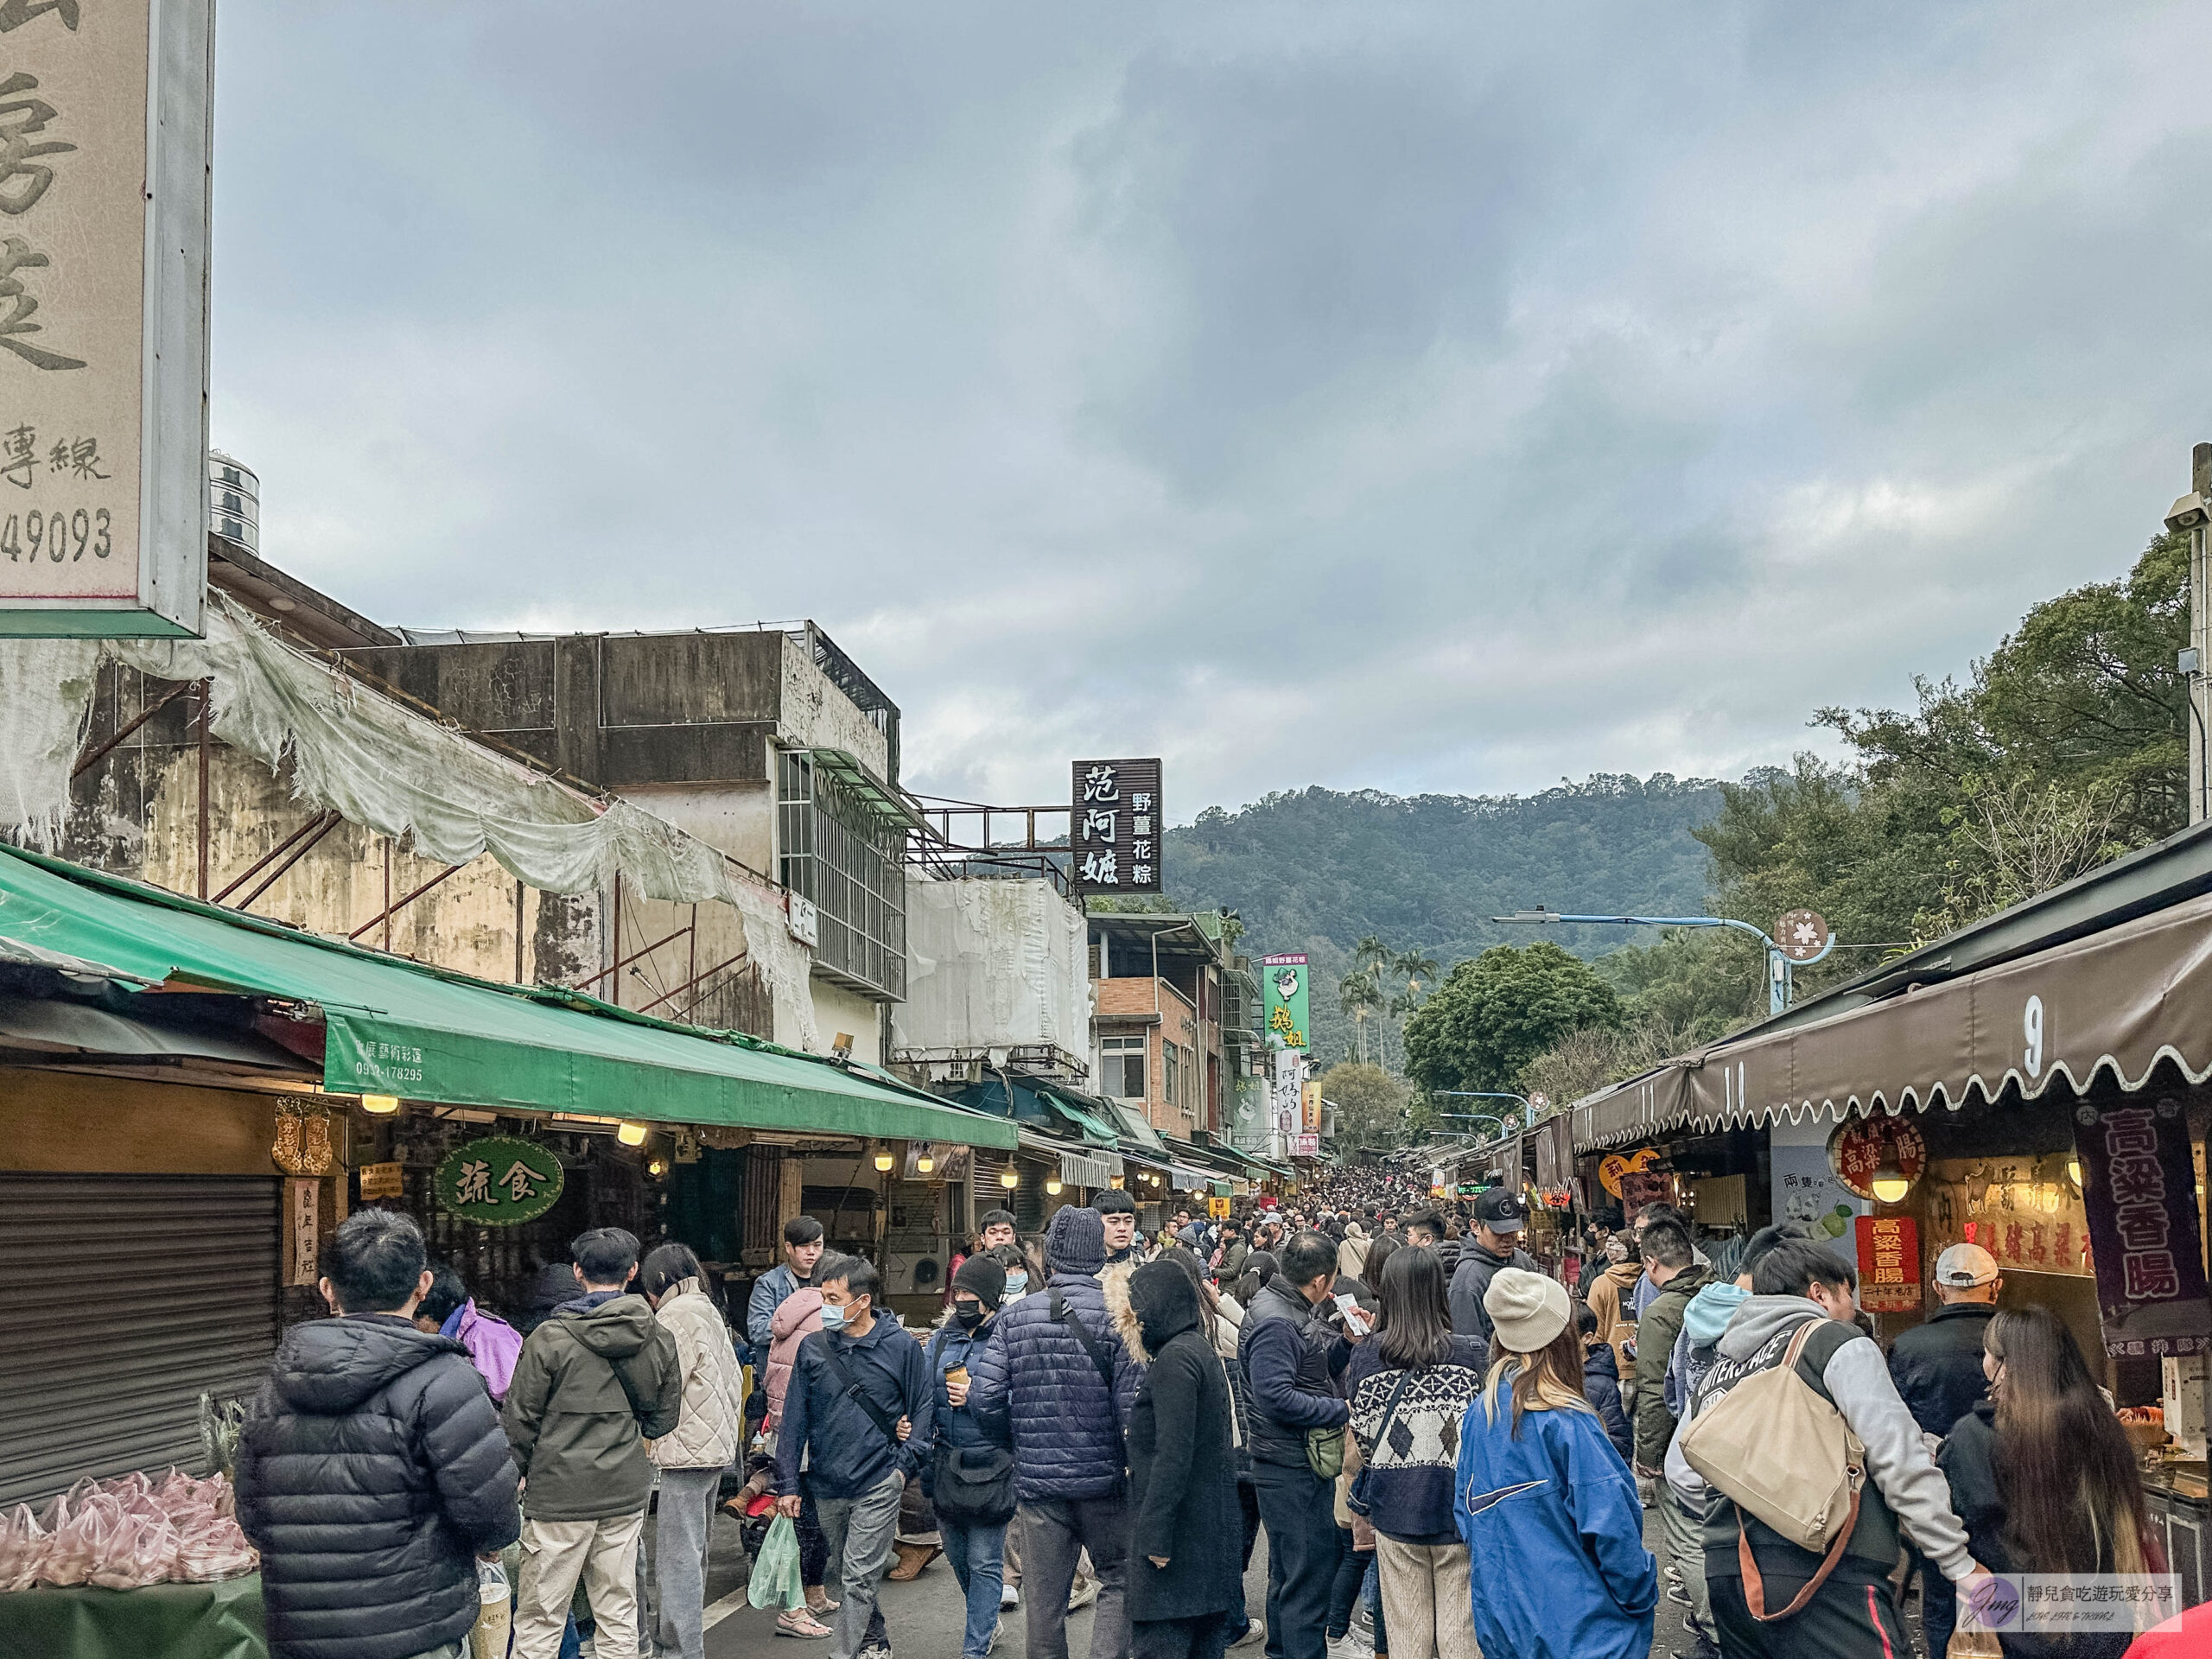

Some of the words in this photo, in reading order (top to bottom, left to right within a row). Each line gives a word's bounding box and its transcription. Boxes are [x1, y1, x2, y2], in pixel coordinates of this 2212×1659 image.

[0, 508, 111, 563] 49093
[1132, 792, 1152, 884] 野薑花粽
[2024, 995, 2043, 1078] 9
[355, 1061, 423, 1082] 0932-178295
[1845, 1133, 1917, 1175] 高粱腸
[456, 1160, 547, 1205] 蔬食
[1872, 1218, 1904, 1284] 高粱香腸
[1863, 1285, 1914, 1297] 二十年老店
